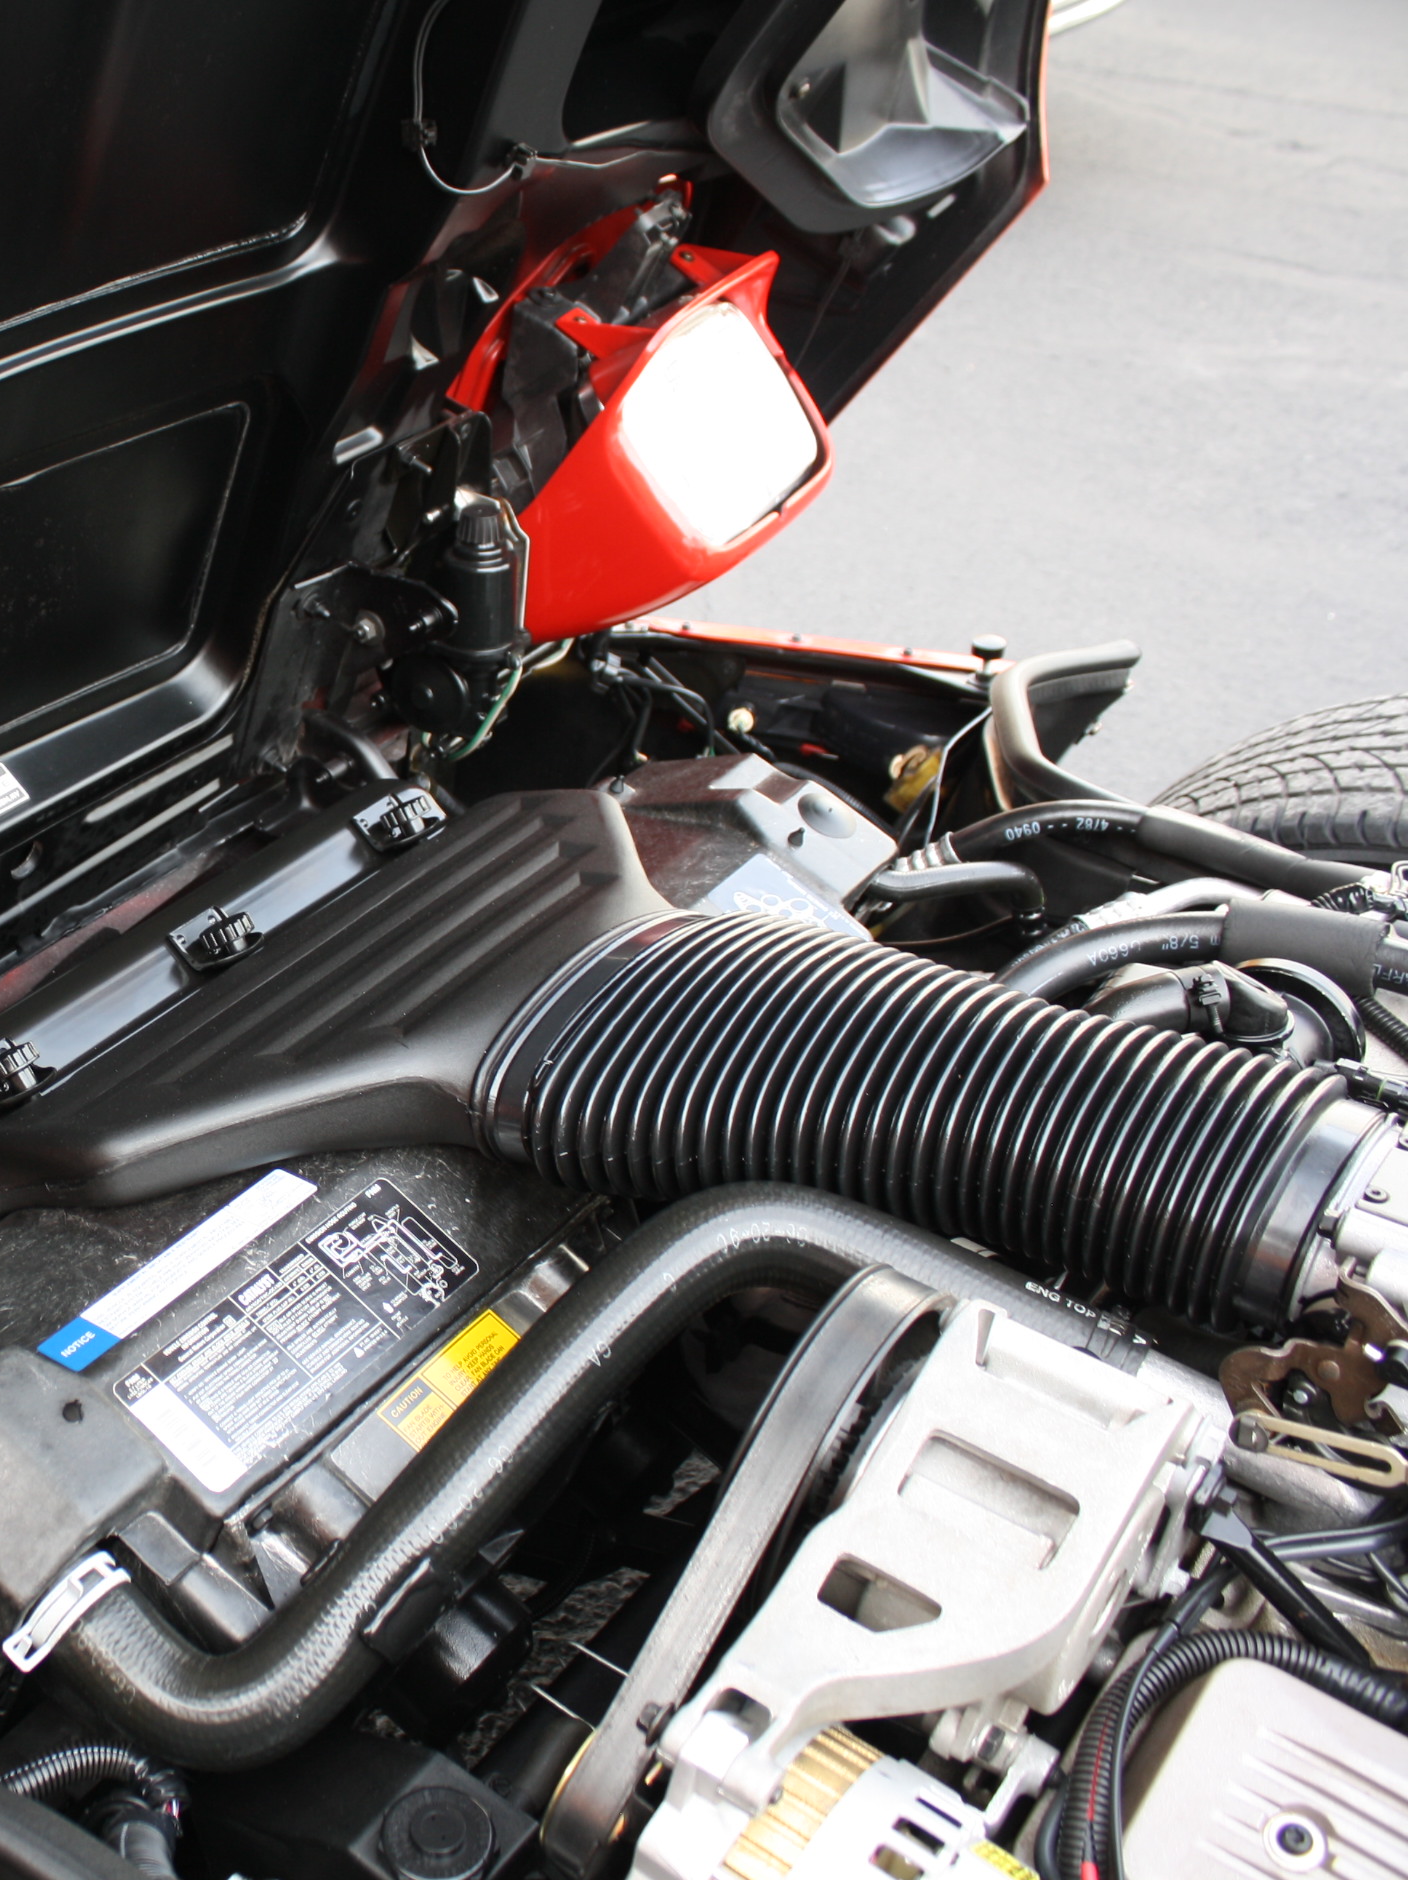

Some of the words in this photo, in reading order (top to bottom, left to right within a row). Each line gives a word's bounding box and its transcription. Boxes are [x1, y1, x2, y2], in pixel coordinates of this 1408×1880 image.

[1004, 820, 1040, 841] 0940
[1162, 933, 1199, 951] 5/8"
[237, 1274, 275, 1306] CATALYST
[1025, 1281, 1061, 1302] ENG
[1066, 1297, 1096, 1319] TOP
[60, 1329, 95, 1358] NOTICE
[450, 1360, 463, 1373] HELP
[476, 1330, 497, 1350] PERSONAL
[467, 1357, 479, 1369] KEEP
[478, 1343, 494, 1358] HANDS
[470, 1364, 481, 1375] FAN
[480, 1353, 495, 1367] BLADE
[494, 1344, 504, 1354] CAN
[390, 1386, 423, 1417] CAUTION
[414, 1404, 432, 1421] BLADE
